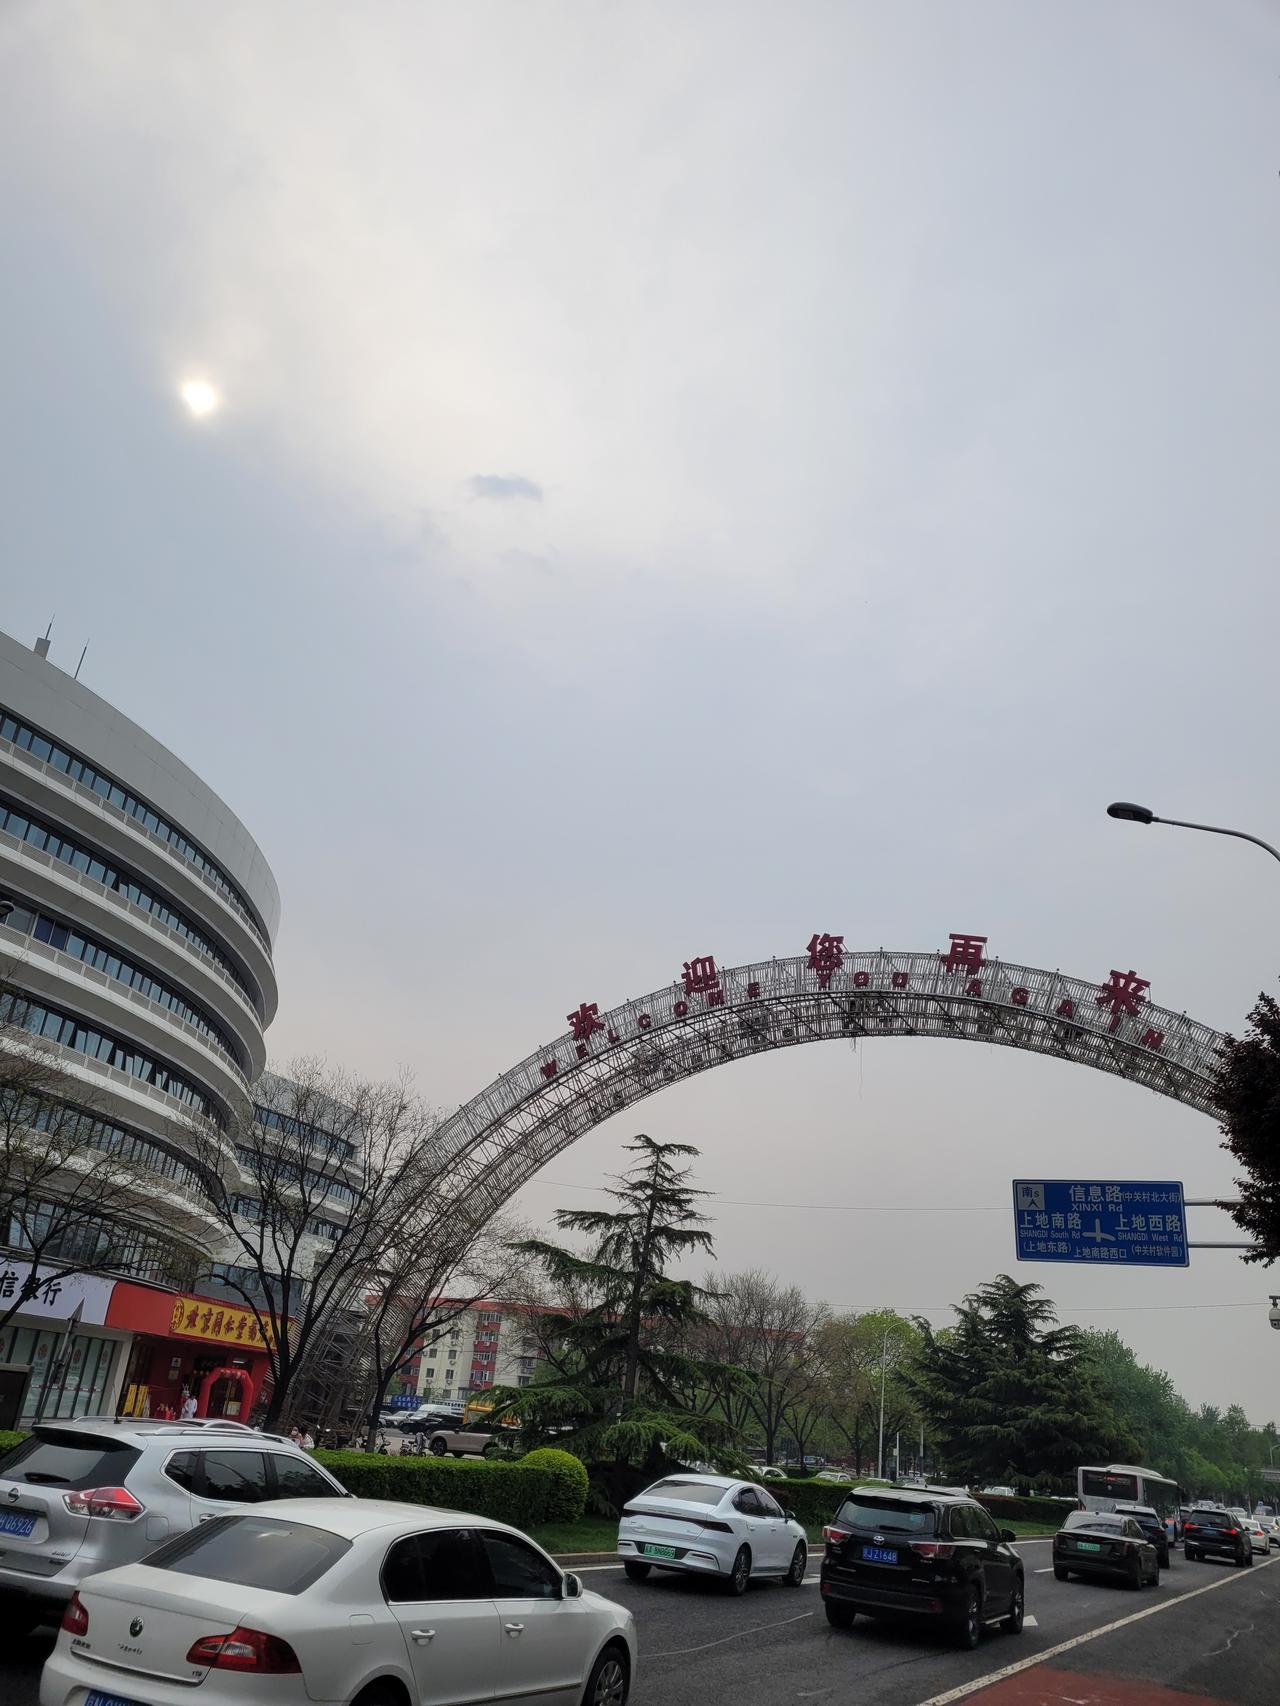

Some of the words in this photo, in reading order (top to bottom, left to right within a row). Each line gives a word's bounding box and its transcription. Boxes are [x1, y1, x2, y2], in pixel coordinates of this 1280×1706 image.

[567, 932, 1150, 1041] 欢迎您再来
[540, 982, 760, 1079] WELCOME
[817, 970, 909, 990] YOU
[965, 980, 1165, 1049] AGAIN
[1069, 1184, 1122, 1202] 信息路
[1072, 1202, 1102, 1212] XINXI
[1108, 1203, 1123, 1212] Rd
[1020, 1211, 1082, 1229] 上地南路
[1114, 1213, 1182, 1232] 上地西路
[1019, 1229, 1048, 1238] SHANGDI
[1050, 1230, 1069, 1239] South
[1072, 1230, 1081, 1239] Rd
[1117, 1231, 1148, 1241] SHANGDI
[1151, 1233, 1169, 1242] West
[1173, 1233, 1183, 1242] Rd
